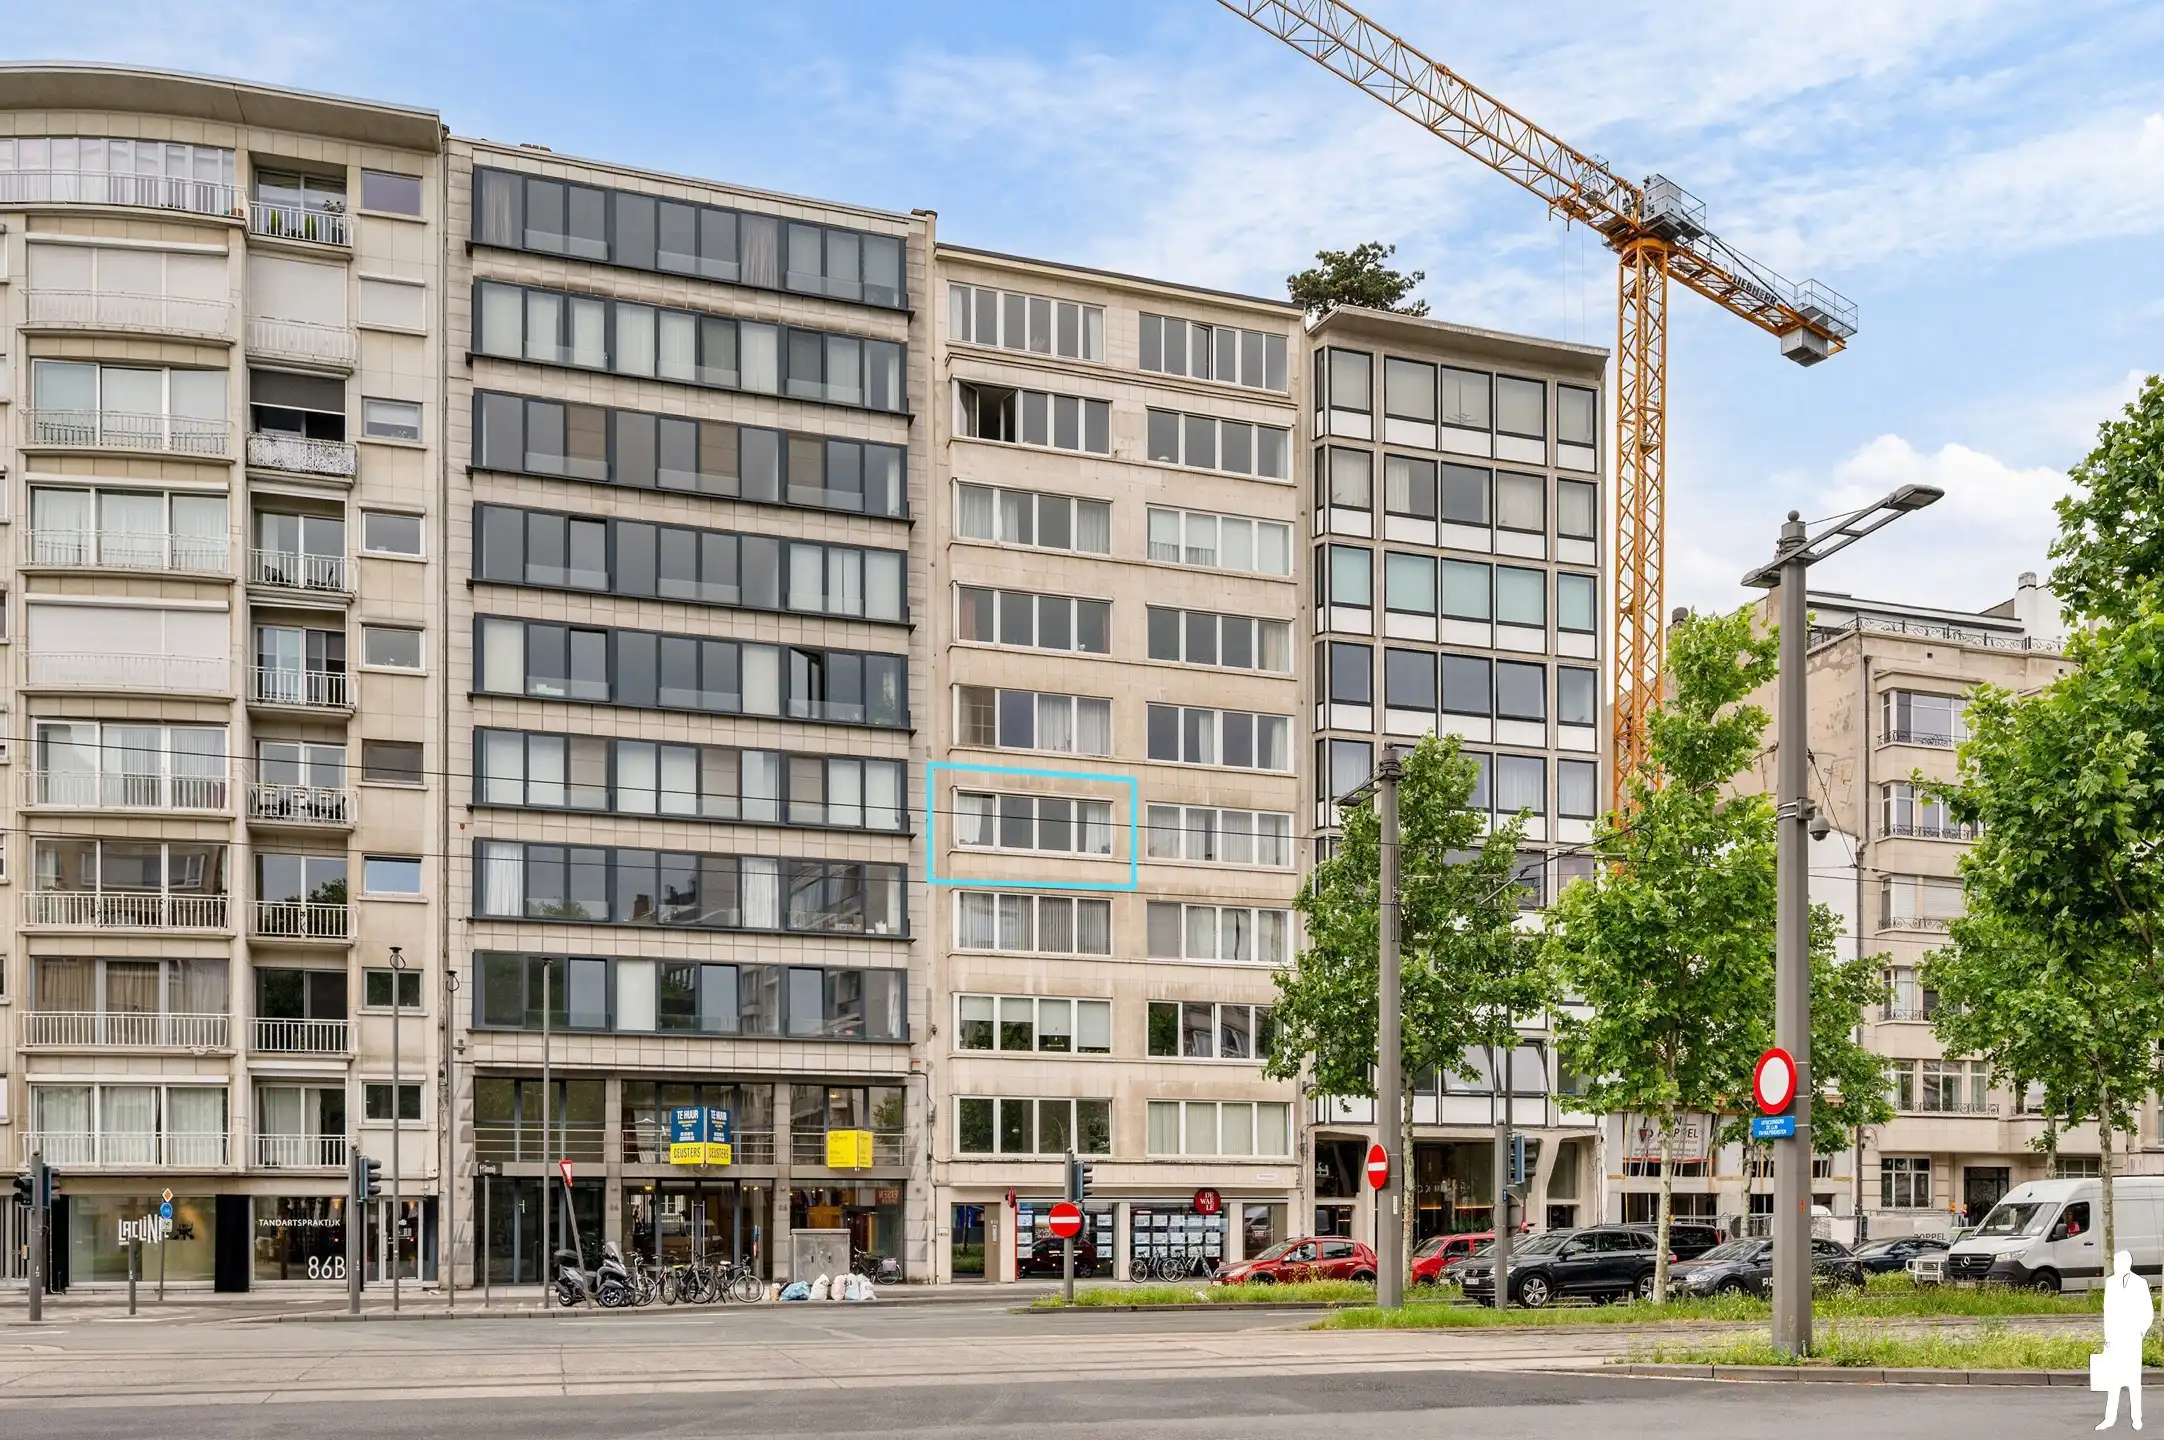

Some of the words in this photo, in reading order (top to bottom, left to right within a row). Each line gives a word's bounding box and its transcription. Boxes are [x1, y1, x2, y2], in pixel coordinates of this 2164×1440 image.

[1732, 273, 1778, 306] LIEBHERR
[677, 1110, 683, 1120] TE
[684, 1110, 698, 1120] HUUR
[258, 1219, 340, 1227] TANDARTSPRAKTIJK
[308, 1256, 346, 1279] 86B
